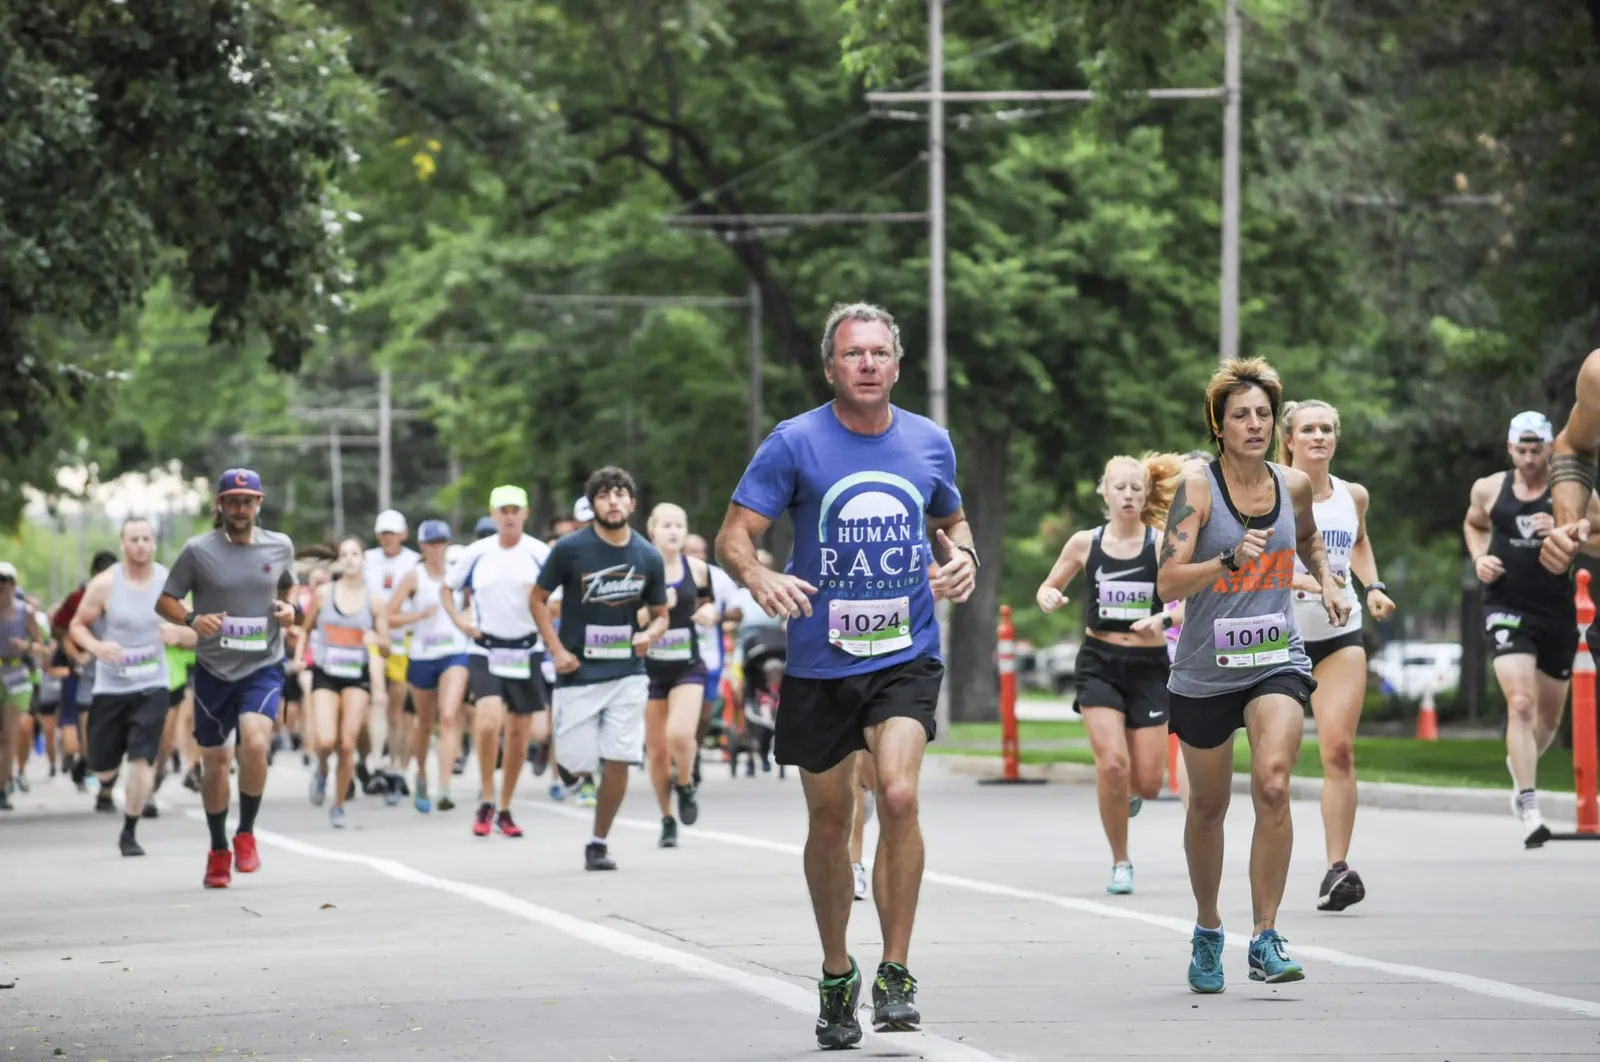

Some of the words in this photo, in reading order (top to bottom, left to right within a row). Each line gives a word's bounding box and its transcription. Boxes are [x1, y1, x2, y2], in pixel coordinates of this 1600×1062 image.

[235, 473, 248, 486] C
[838, 525, 911, 543] HUMAN
[820, 544, 923, 577] RACE
[1228, 549, 1295, 577] ANIC
[819, 580, 854, 589] FORT
[865, 576, 920, 589] COLLINS
[1107, 590, 1148, 603] 1045
[840, 611, 901, 632] 1024
[1225, 626, 1280, 647] 1010
